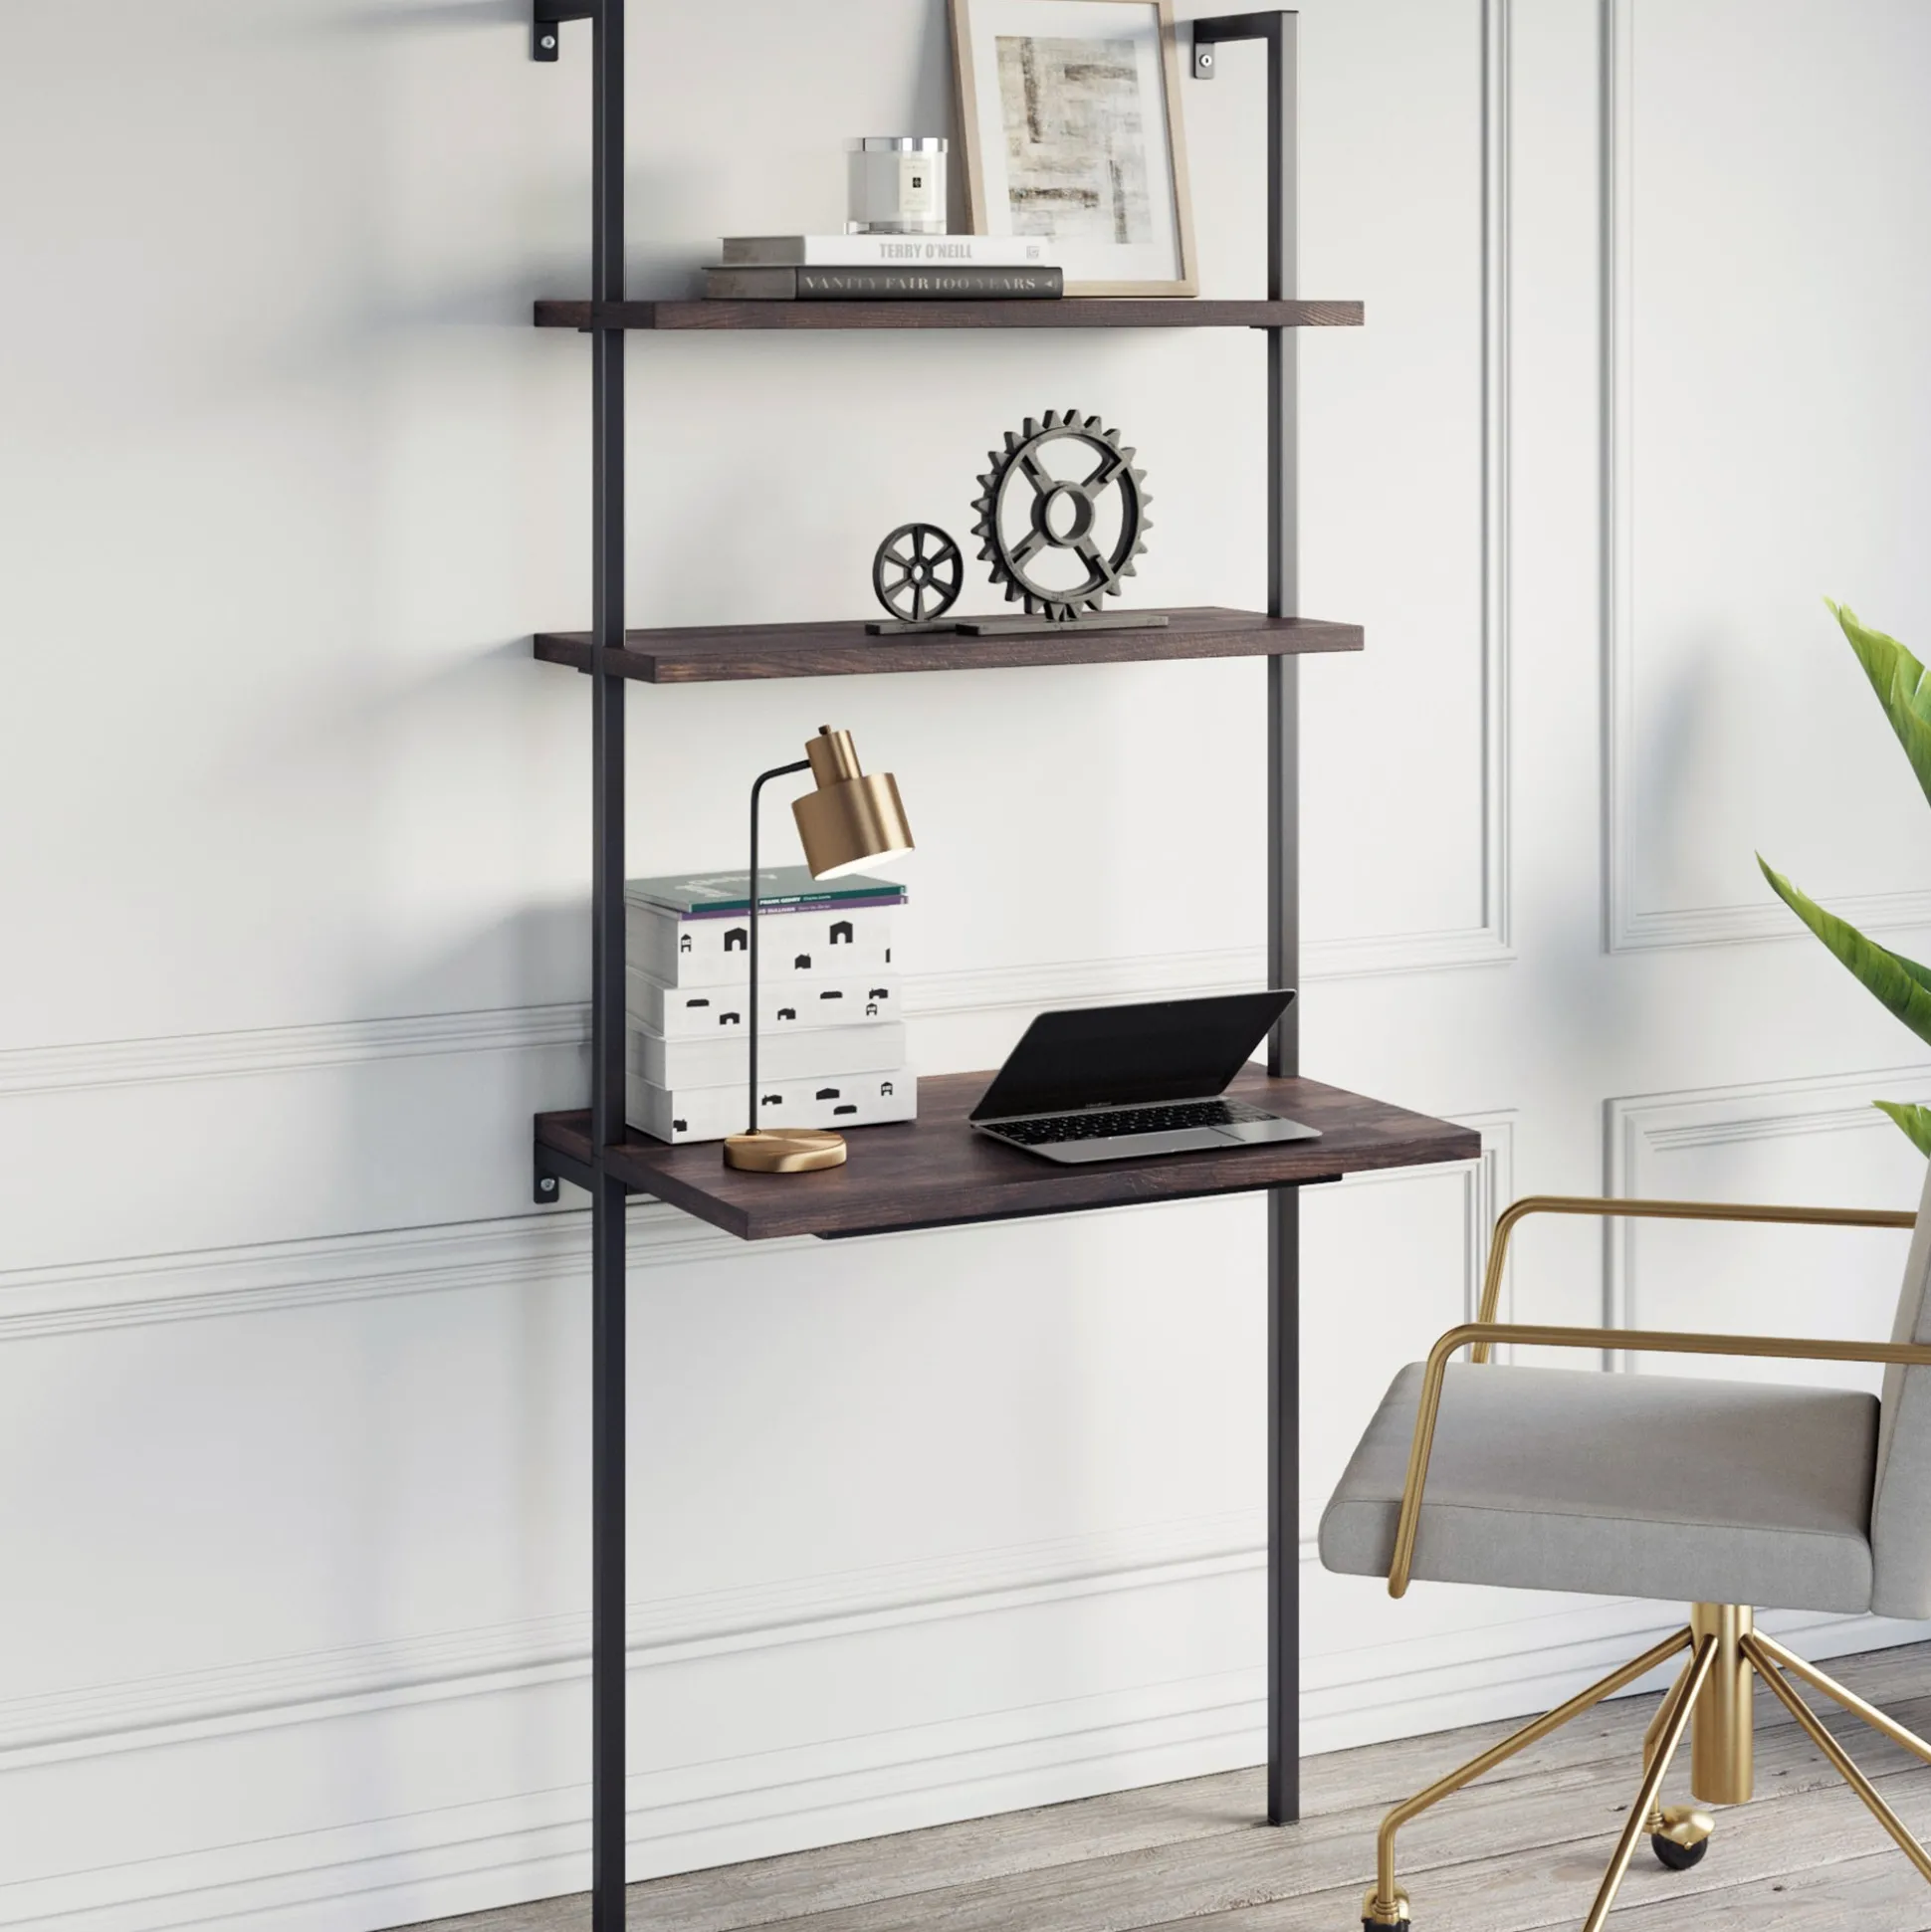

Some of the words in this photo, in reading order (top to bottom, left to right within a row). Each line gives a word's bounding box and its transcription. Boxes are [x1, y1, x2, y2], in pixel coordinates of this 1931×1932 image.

[879, 243, 922, 259] TERRY
[926, 243, 972, 259] O'NEILL
[804, 277, 876, 290] VANITY
[885, 277, 929, 290] FAIR
[975, 278, 1037, 291] YEARS
